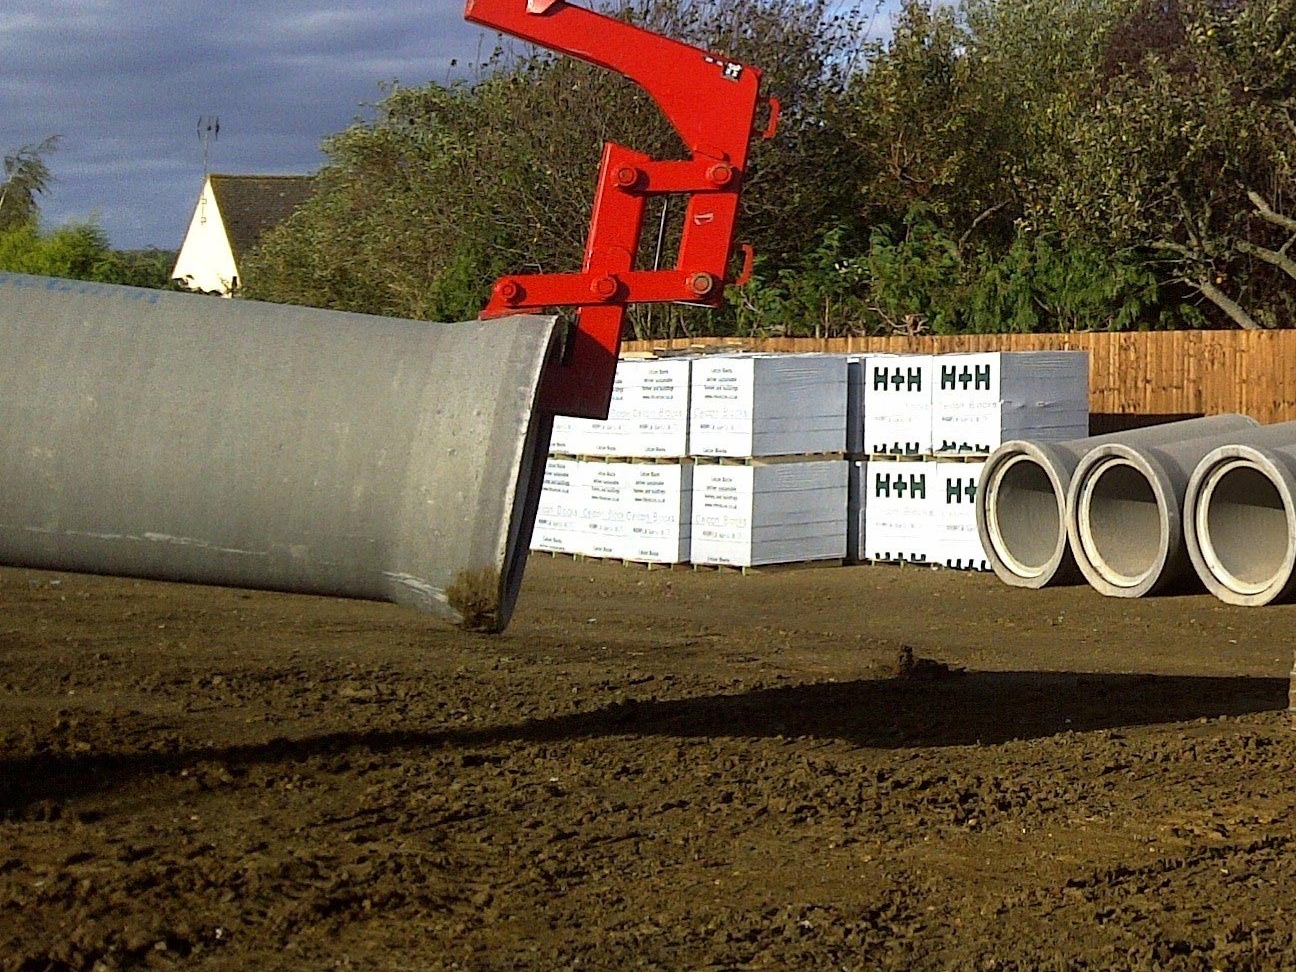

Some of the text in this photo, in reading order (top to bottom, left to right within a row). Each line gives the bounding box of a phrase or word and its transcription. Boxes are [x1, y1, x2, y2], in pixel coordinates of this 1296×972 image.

[874, 367, 921, 392] H+H
[941, 364, 990, 390] H+H
[875, 472, 925, 499] H+H
